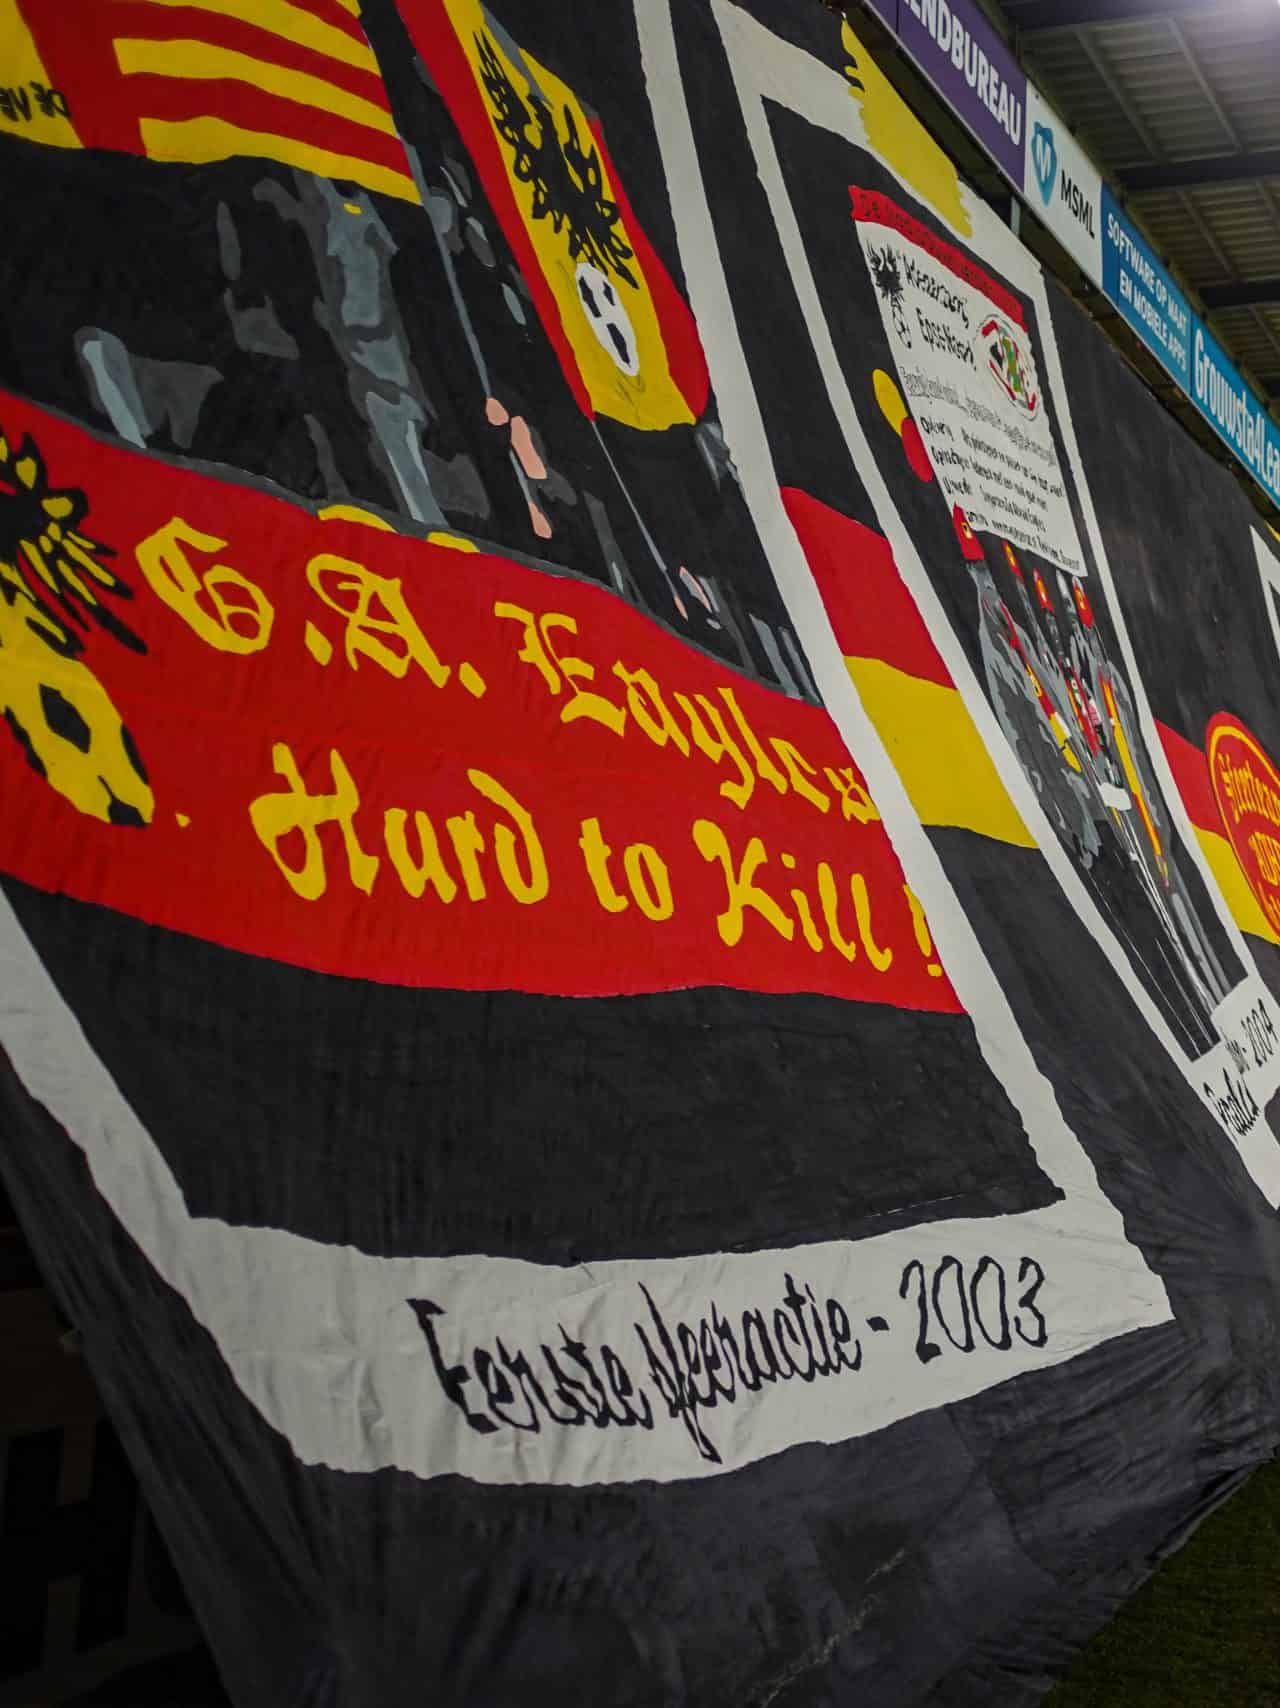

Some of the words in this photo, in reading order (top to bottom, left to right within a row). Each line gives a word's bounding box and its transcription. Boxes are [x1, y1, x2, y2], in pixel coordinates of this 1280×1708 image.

[904, 0, 1022, 146] NDBUREAU
[1060, 169, 1096, 240] MSML
[1106, 212, 1156, 289] SOFTWARE
[1155, 275, 1168, 304] OP
[1119, 268, 1133, 301] EN
[1133, 284, 1167, 348] MOBIELE
[249, 742, 549, 905] Hard
[580, 817, 674, 921] to
[898, 1256, 1046, 1364] 2003
